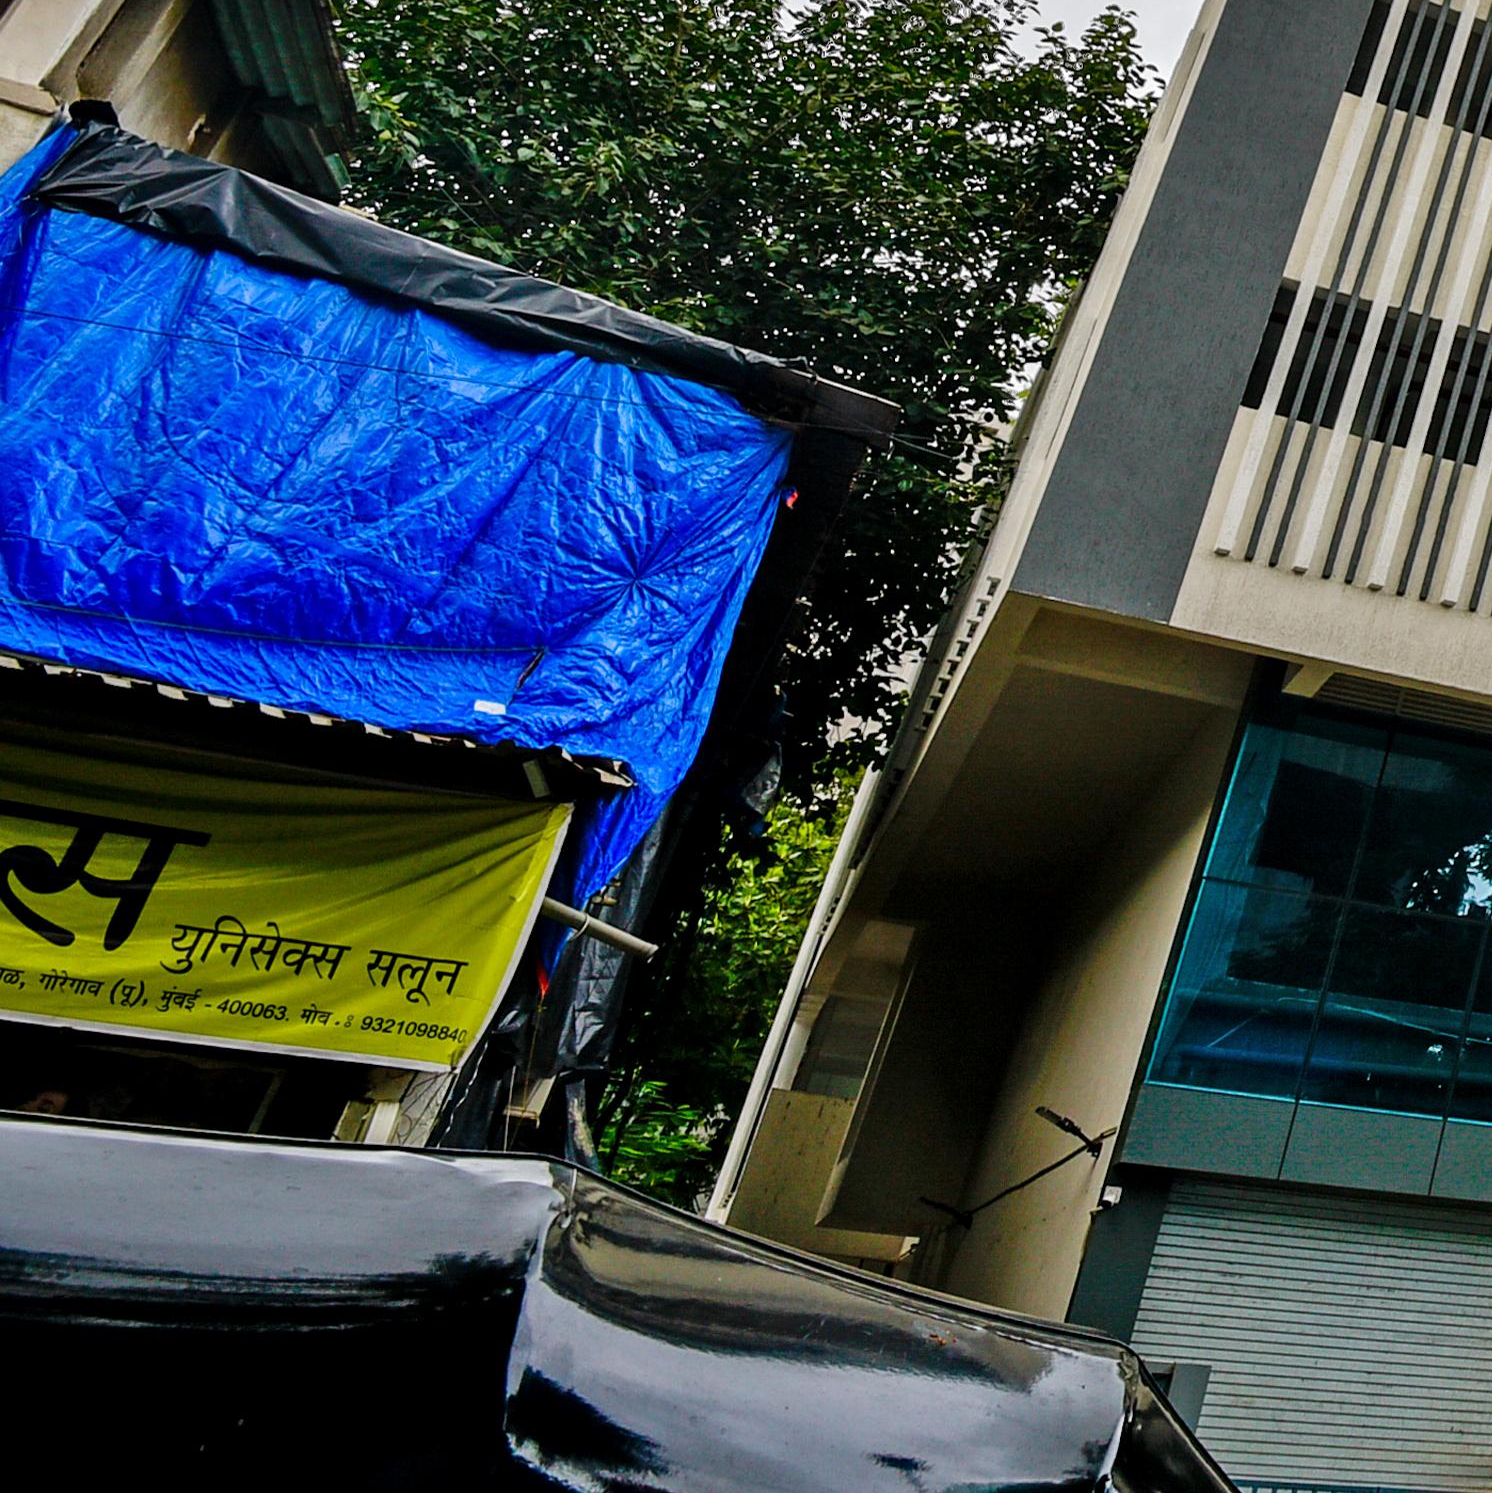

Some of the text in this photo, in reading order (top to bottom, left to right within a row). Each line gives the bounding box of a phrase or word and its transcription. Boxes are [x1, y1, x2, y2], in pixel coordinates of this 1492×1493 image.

[160, 915, 469, 1007] युनिसेक्स सलून
[217, 998, 290, 1022] 400063.
[361, 1016, 468, 1044] 9321098840
